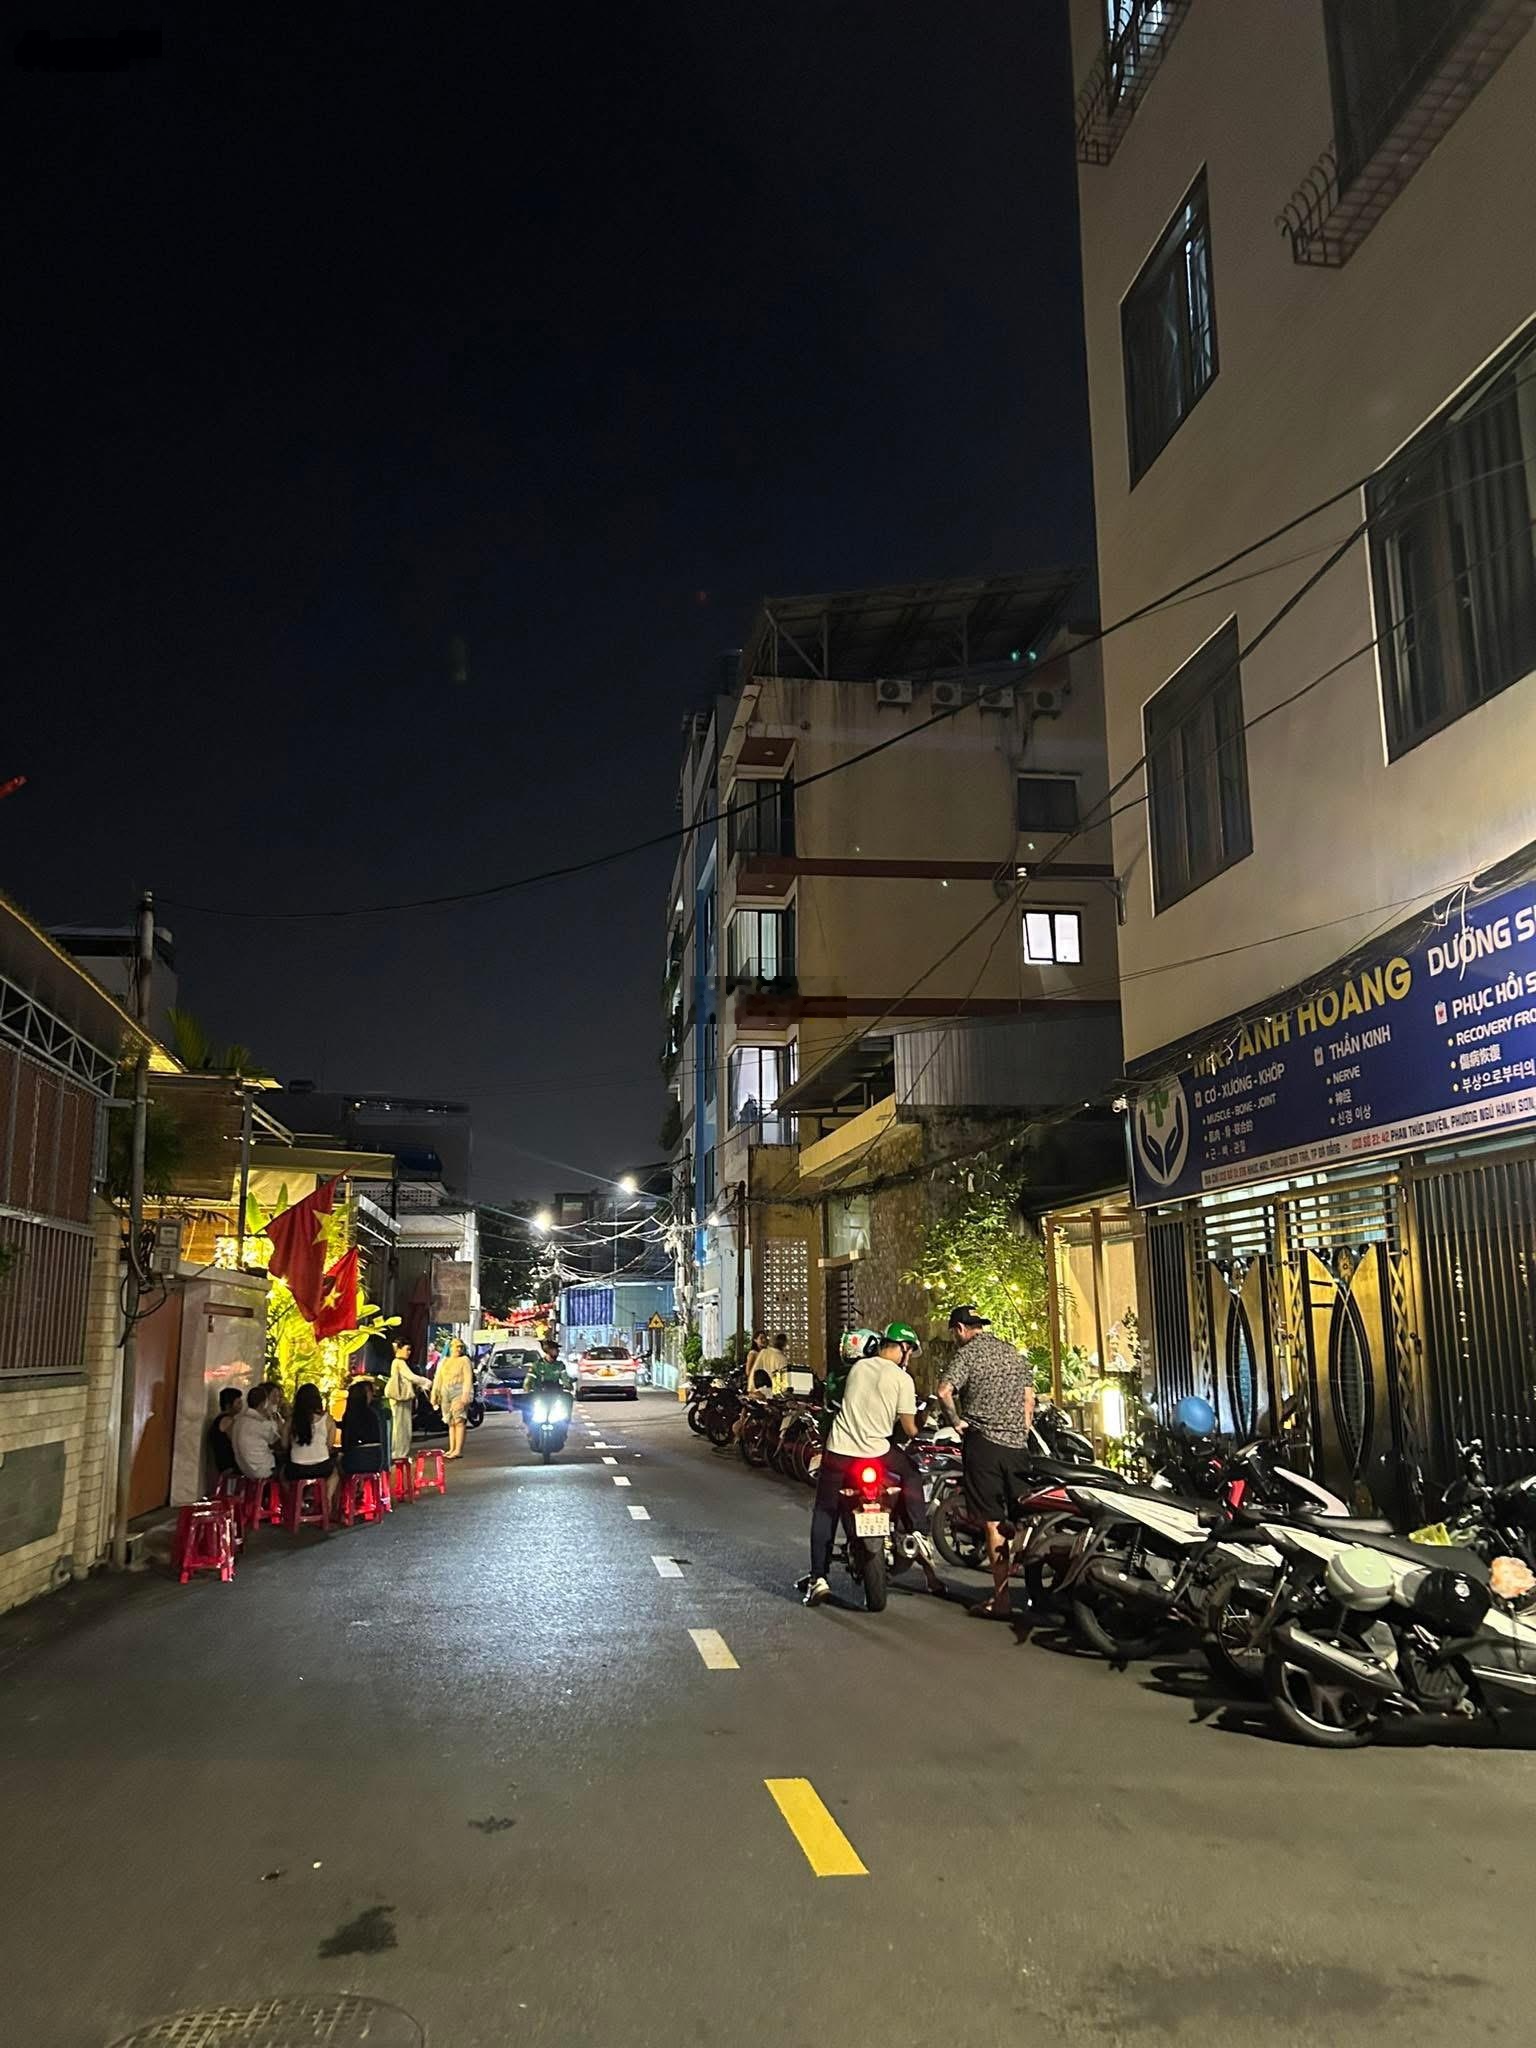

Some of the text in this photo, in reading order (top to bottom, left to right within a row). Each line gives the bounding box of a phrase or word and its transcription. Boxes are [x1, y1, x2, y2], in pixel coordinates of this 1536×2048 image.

[1452, 987, 1494, 1019] PHỤC
[1495, 971, 1524, 1005] HỒI
[1238, 1015, 1291, 1061] ANH
[1328, 1024, 1392, 1060] THẦN KINH
[1456, 1014, 1513, 1046] RECOVERY
[1333, 1065, 1361, 1085] NERVE
[1206, 1109, 1232, 1125] MUSCLE
[1257, 1093, 1277, 1108] JOINT
